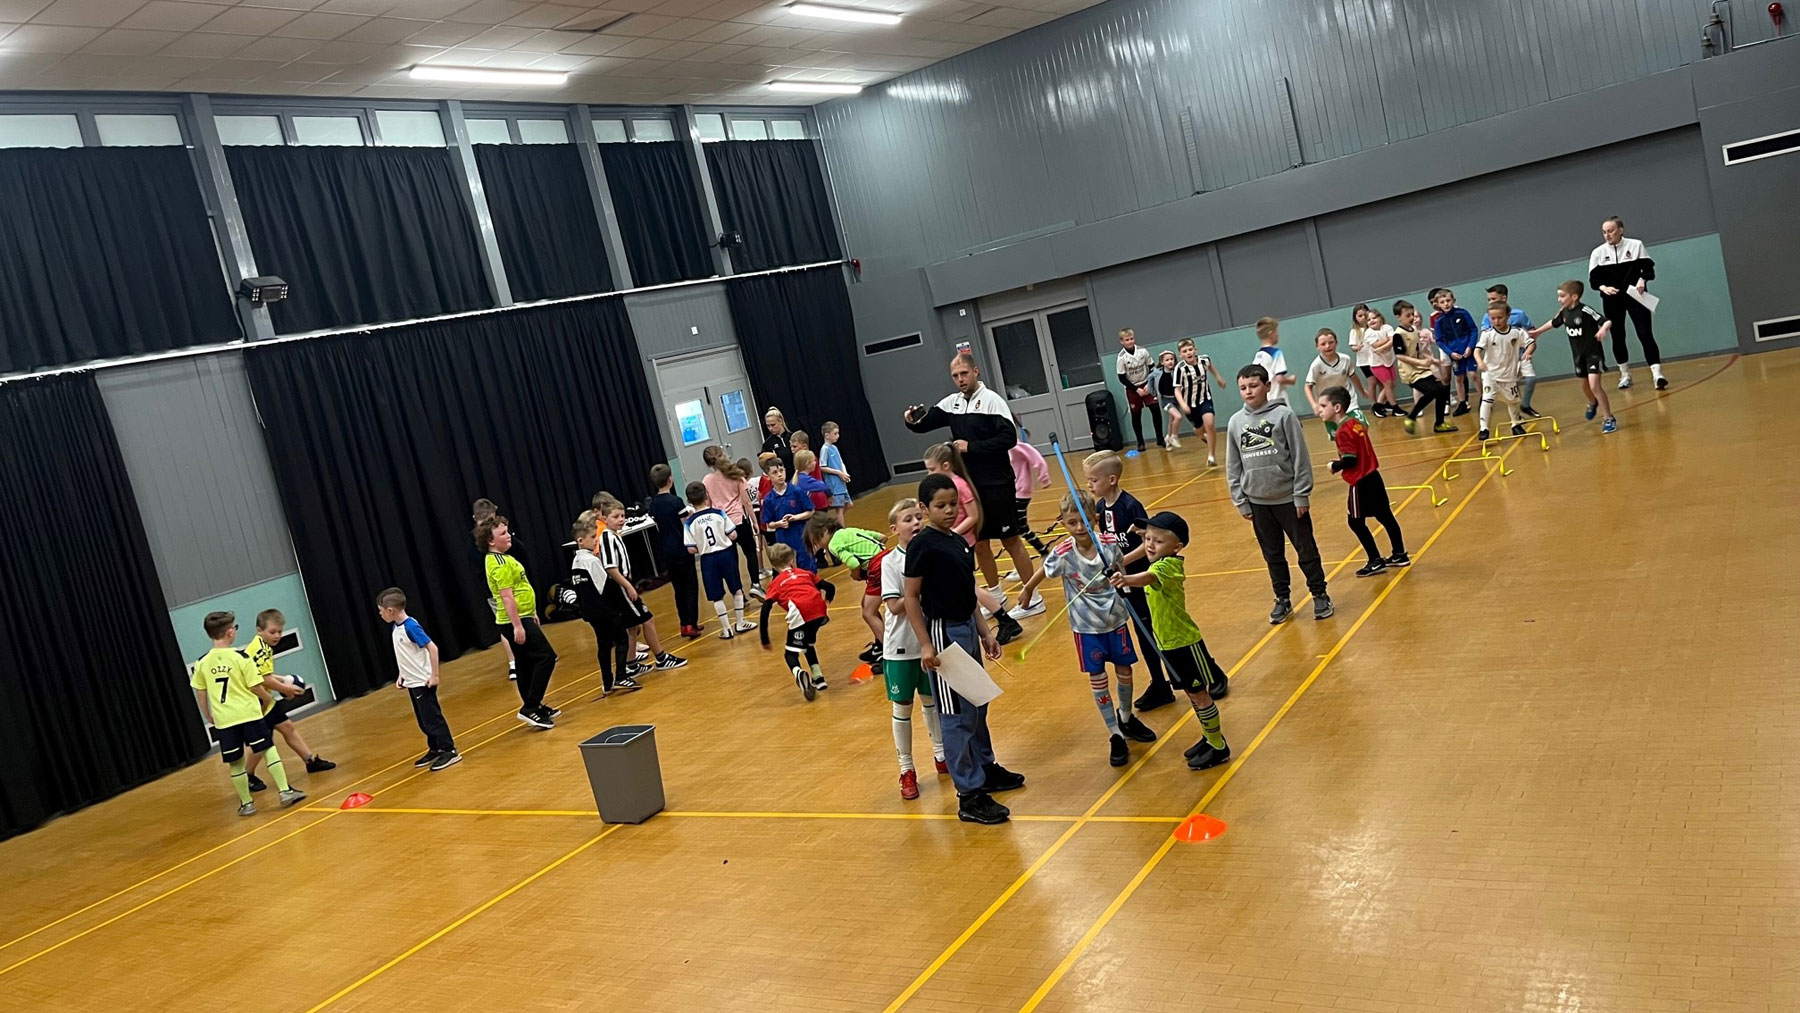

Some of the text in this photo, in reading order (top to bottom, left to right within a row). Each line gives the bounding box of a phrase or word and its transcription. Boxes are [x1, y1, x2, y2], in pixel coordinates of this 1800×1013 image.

[704, 525, 717, 547] 9
[1116, 625, 1127, 648] 7
[210, 665, 232, 675] OZZY
[214, 676, 229, 704] 7
